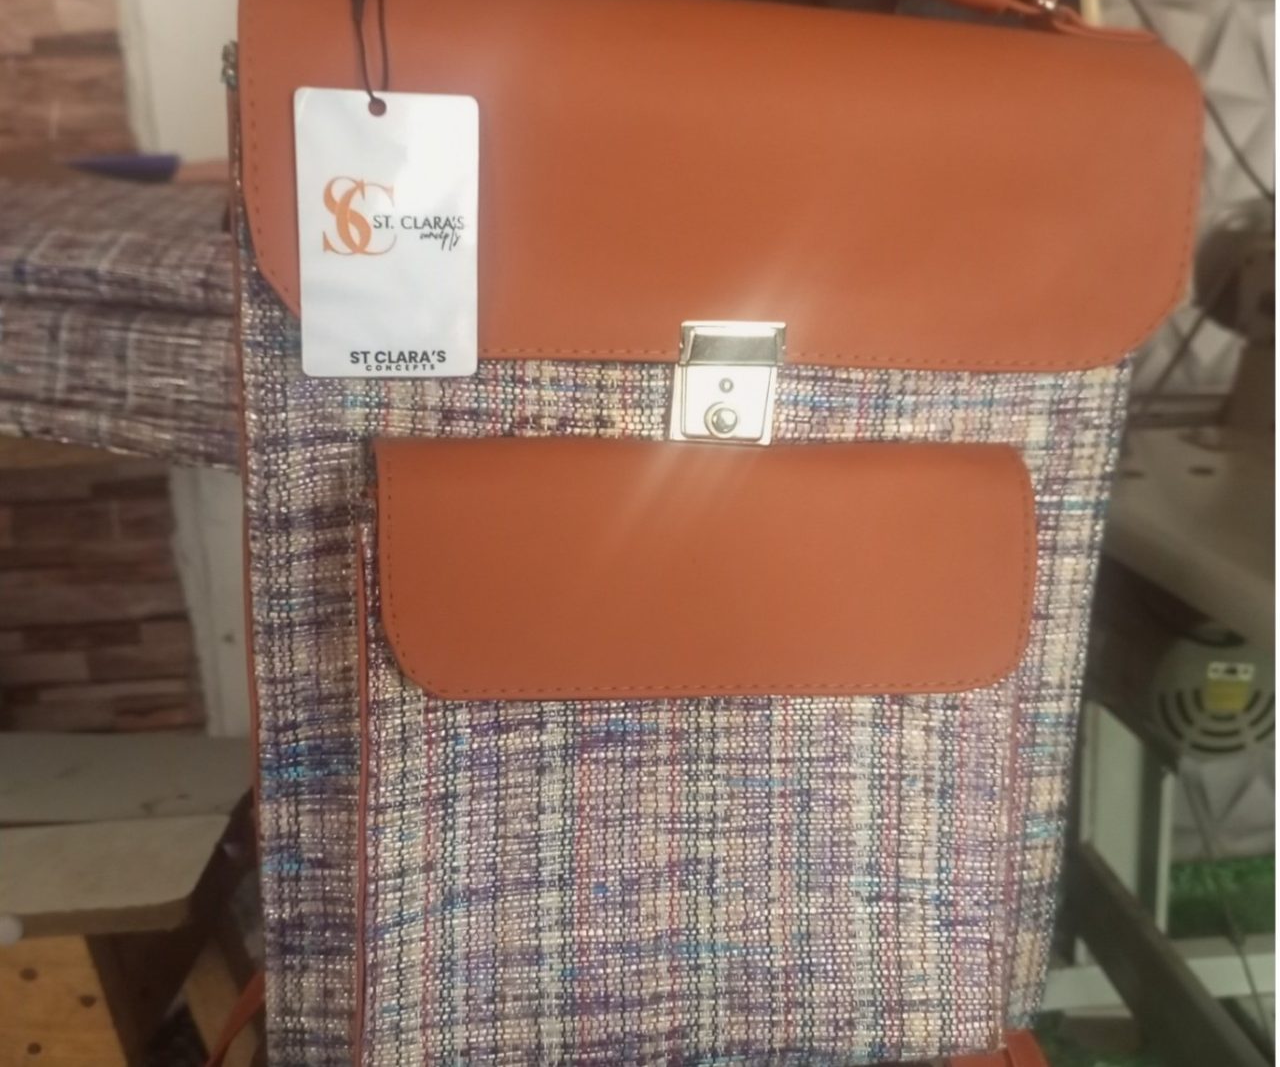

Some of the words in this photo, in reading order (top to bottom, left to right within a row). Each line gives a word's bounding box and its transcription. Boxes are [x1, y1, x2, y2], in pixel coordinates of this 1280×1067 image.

[373, 215, 394, 229] ST.
[400, 215, 465, 230] CLARA'S
[350, 351, 371, 364] ST
[374, 350, 446, 364] CLARA'S
